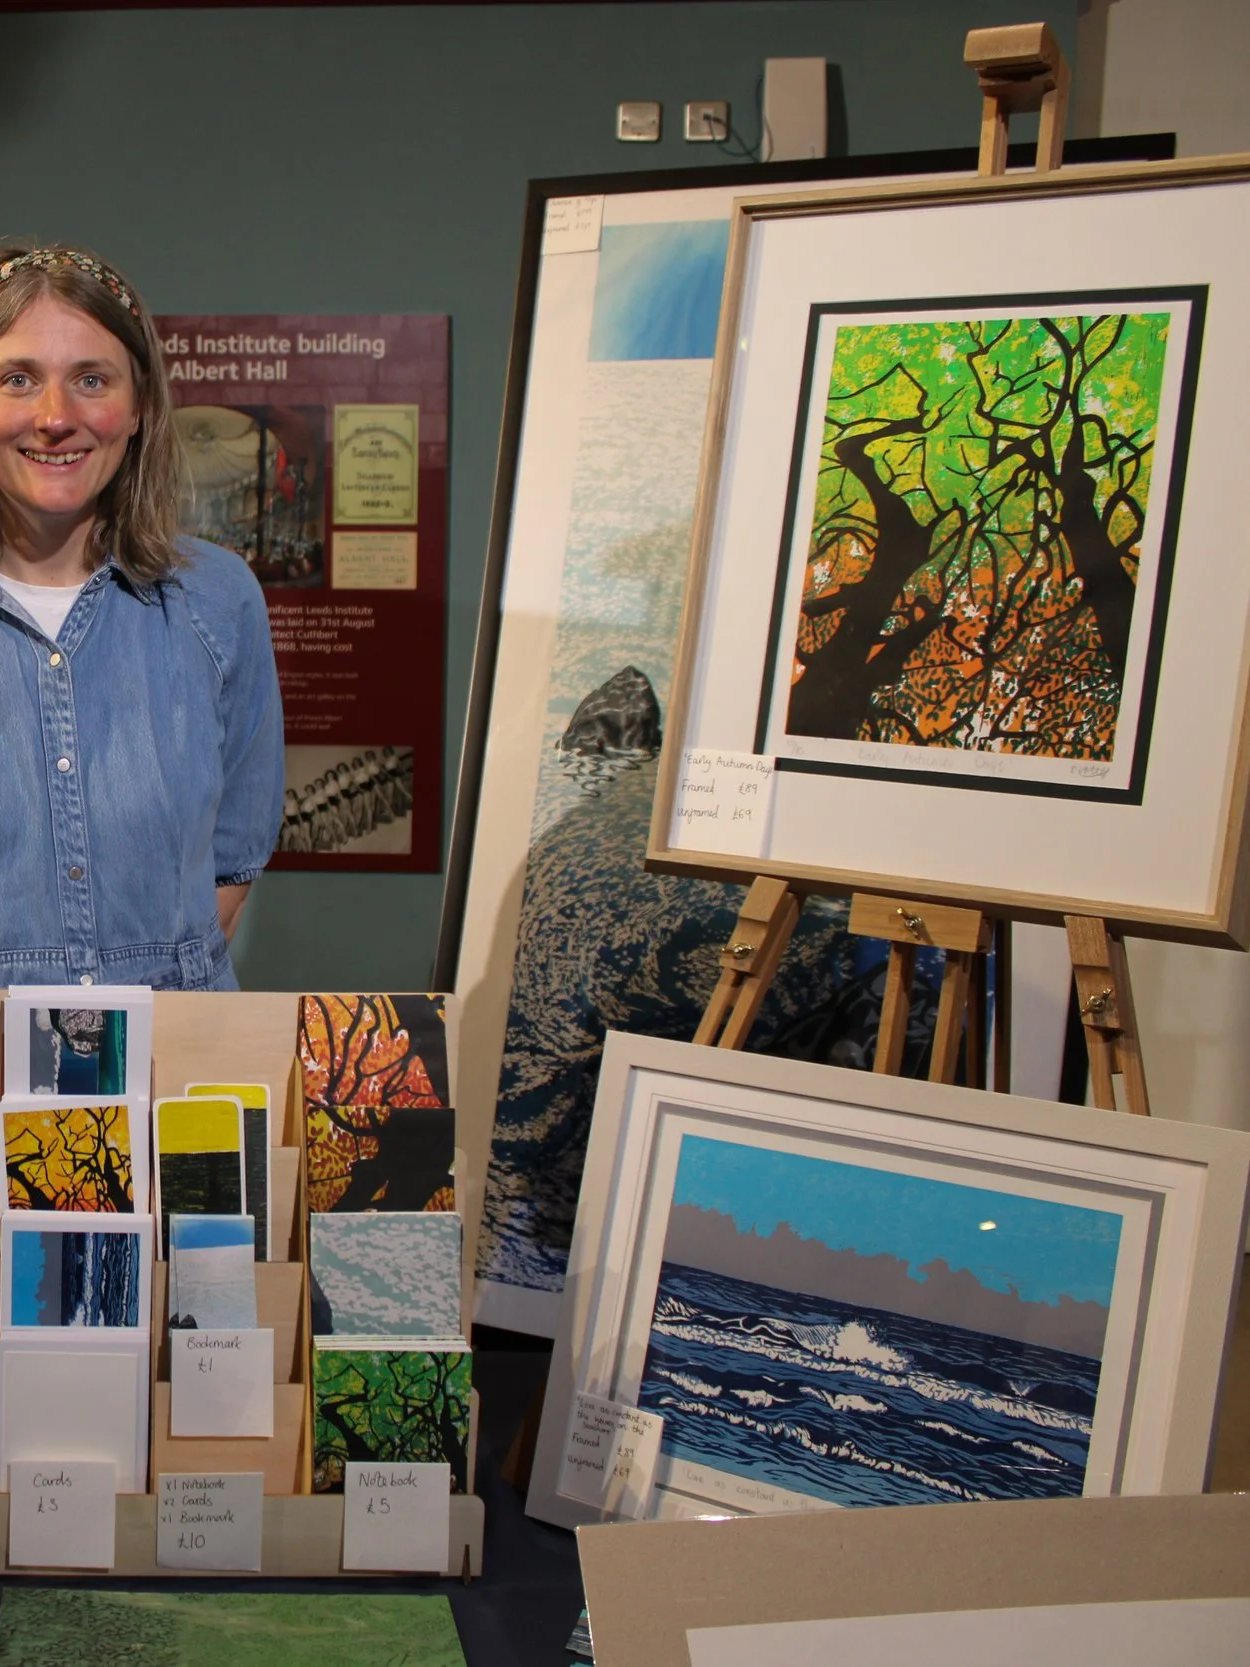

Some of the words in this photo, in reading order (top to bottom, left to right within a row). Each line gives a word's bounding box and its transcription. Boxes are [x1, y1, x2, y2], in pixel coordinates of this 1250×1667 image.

[160, 333, 189, 354] ds
[196, 333, 291, 354] Institute
[297, 333, 386, 358] building
[170, 360, 239, 380] Albert
[247, 360, 288, 380] Hall
[267, 605, 303, 615] nificent
[306, 605, 332, 615] Leeds
[335, 605, 373, 615] Institute
[288, 618, 304, 627] laid
[343, 618, 375, 629] August
[297, 630, 338, 639] Cuthbert
[301, 642, 331, 654] having
[333, 643, 353, 652] cost
[681, 778, 715, 795] Framed
[733, 805, 752, 820] £69
[187, 1335, 241, 1350] Bookmark
[198, 1357, 213, 1373] £1
[572, 1432, 600, 1447] Framed
[33, 1471, 72, 1488] Cards
[182, 1478, 225, 1491] Notebook
[38, 1495, 58, 1513] £3
[182, 1492, 213, 1507] Cards
[366, 1497, 390, 1514] £5
[178, 1531, 206, 1549] £10
